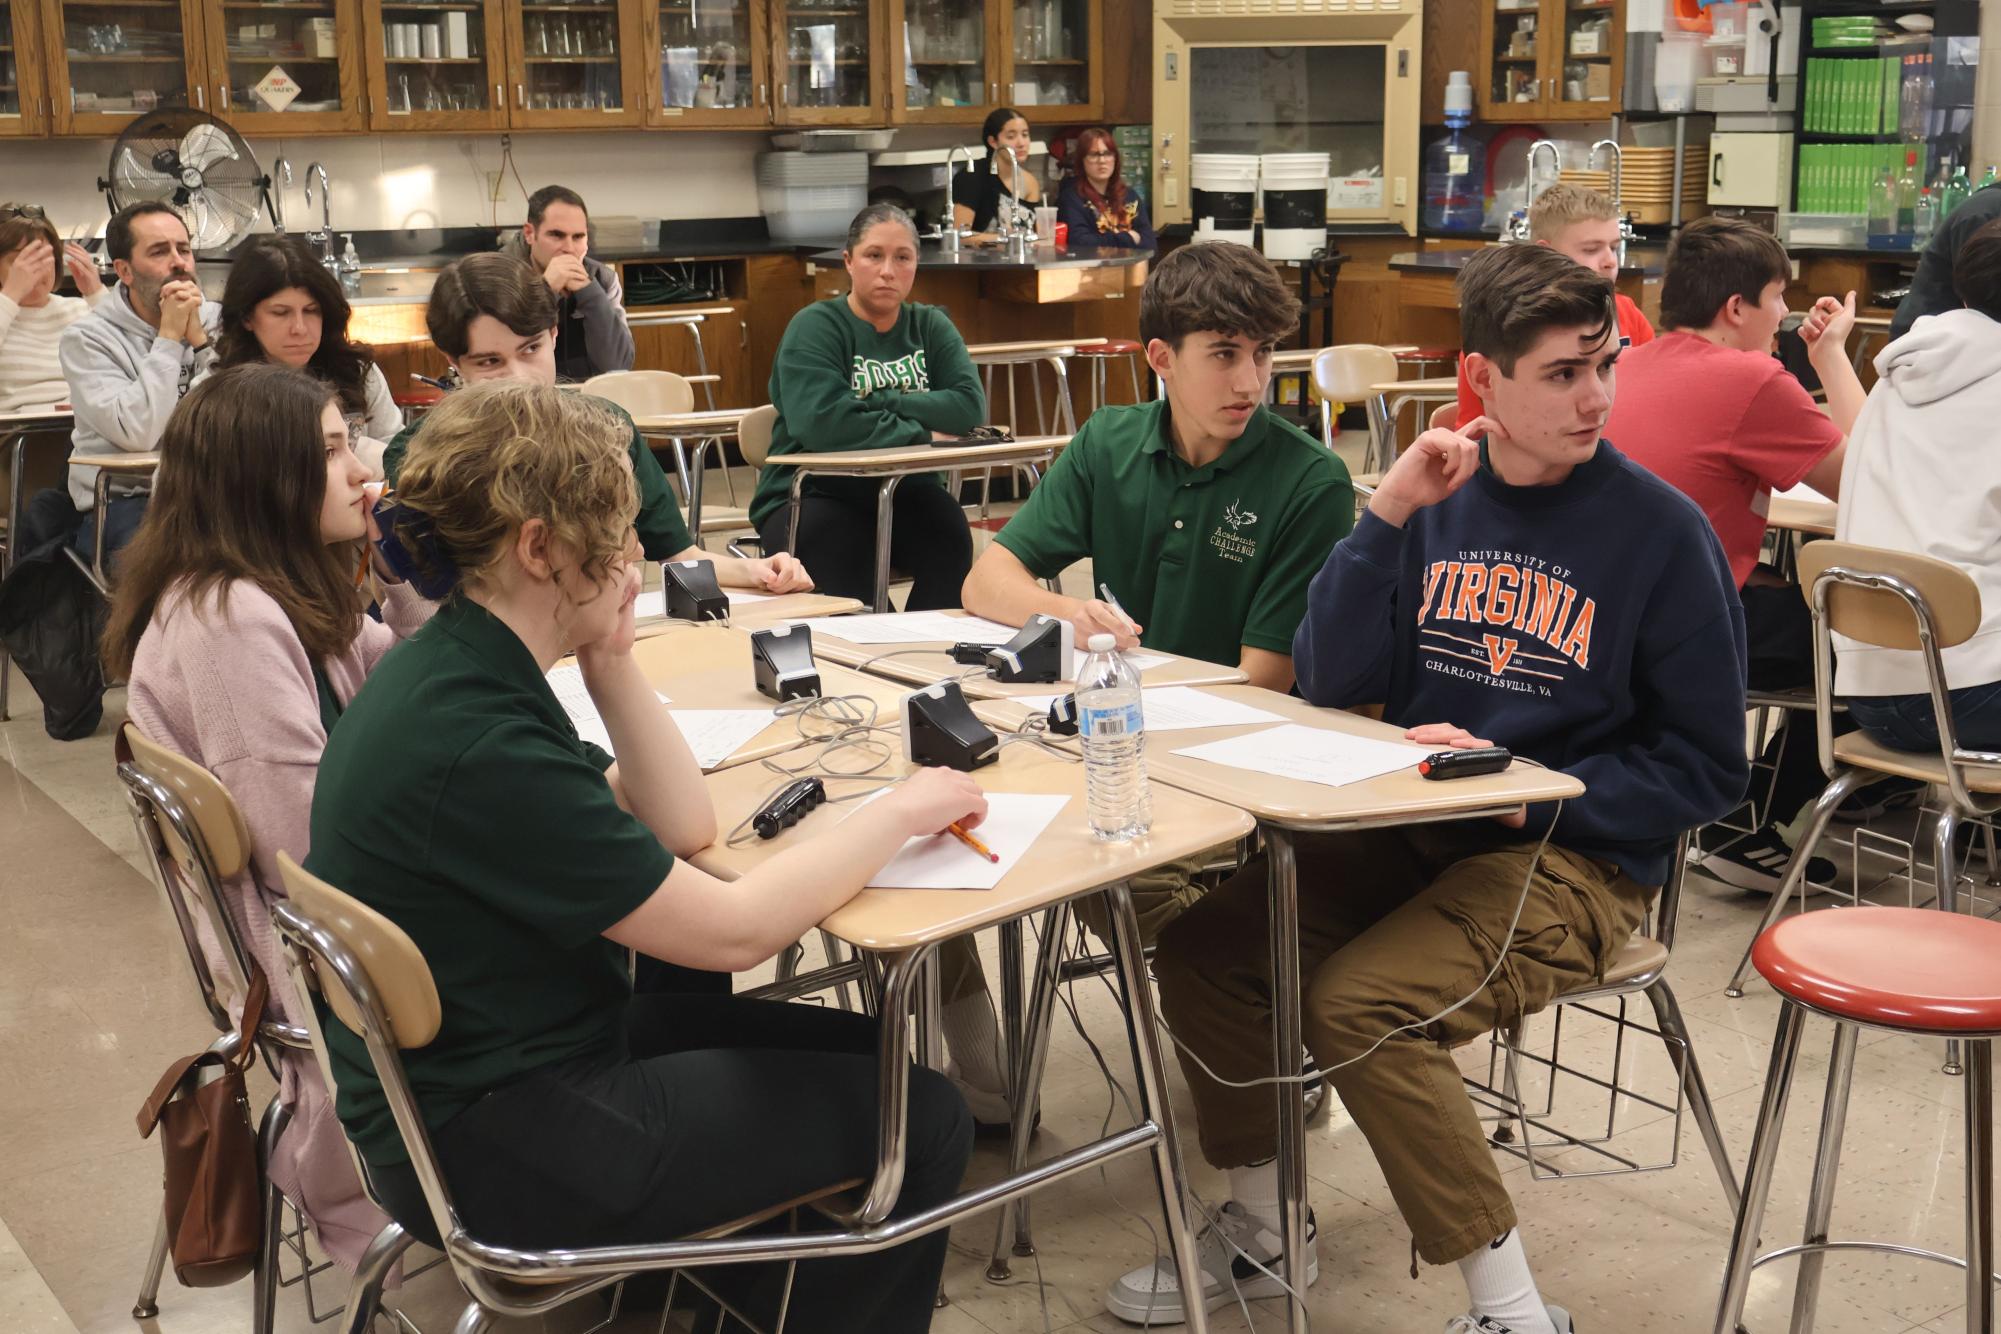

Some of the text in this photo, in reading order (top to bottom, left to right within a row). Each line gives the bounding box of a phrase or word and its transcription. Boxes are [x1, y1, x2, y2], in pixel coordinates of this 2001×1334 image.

[1210, 535, 1256, 557] CHALLENGE
[1215, 526, 1256, 547] Academic
[1219, 547, 1243, 563] Team
[1459, 550, 1572, 579] UNIVERSITY OF
[1418, 561, 1596, 669] VIRGINIA
[1483, 633, 1518, 676] V
[1425, 660, 1552, 697] CHARLOTTESVILLE, VA
